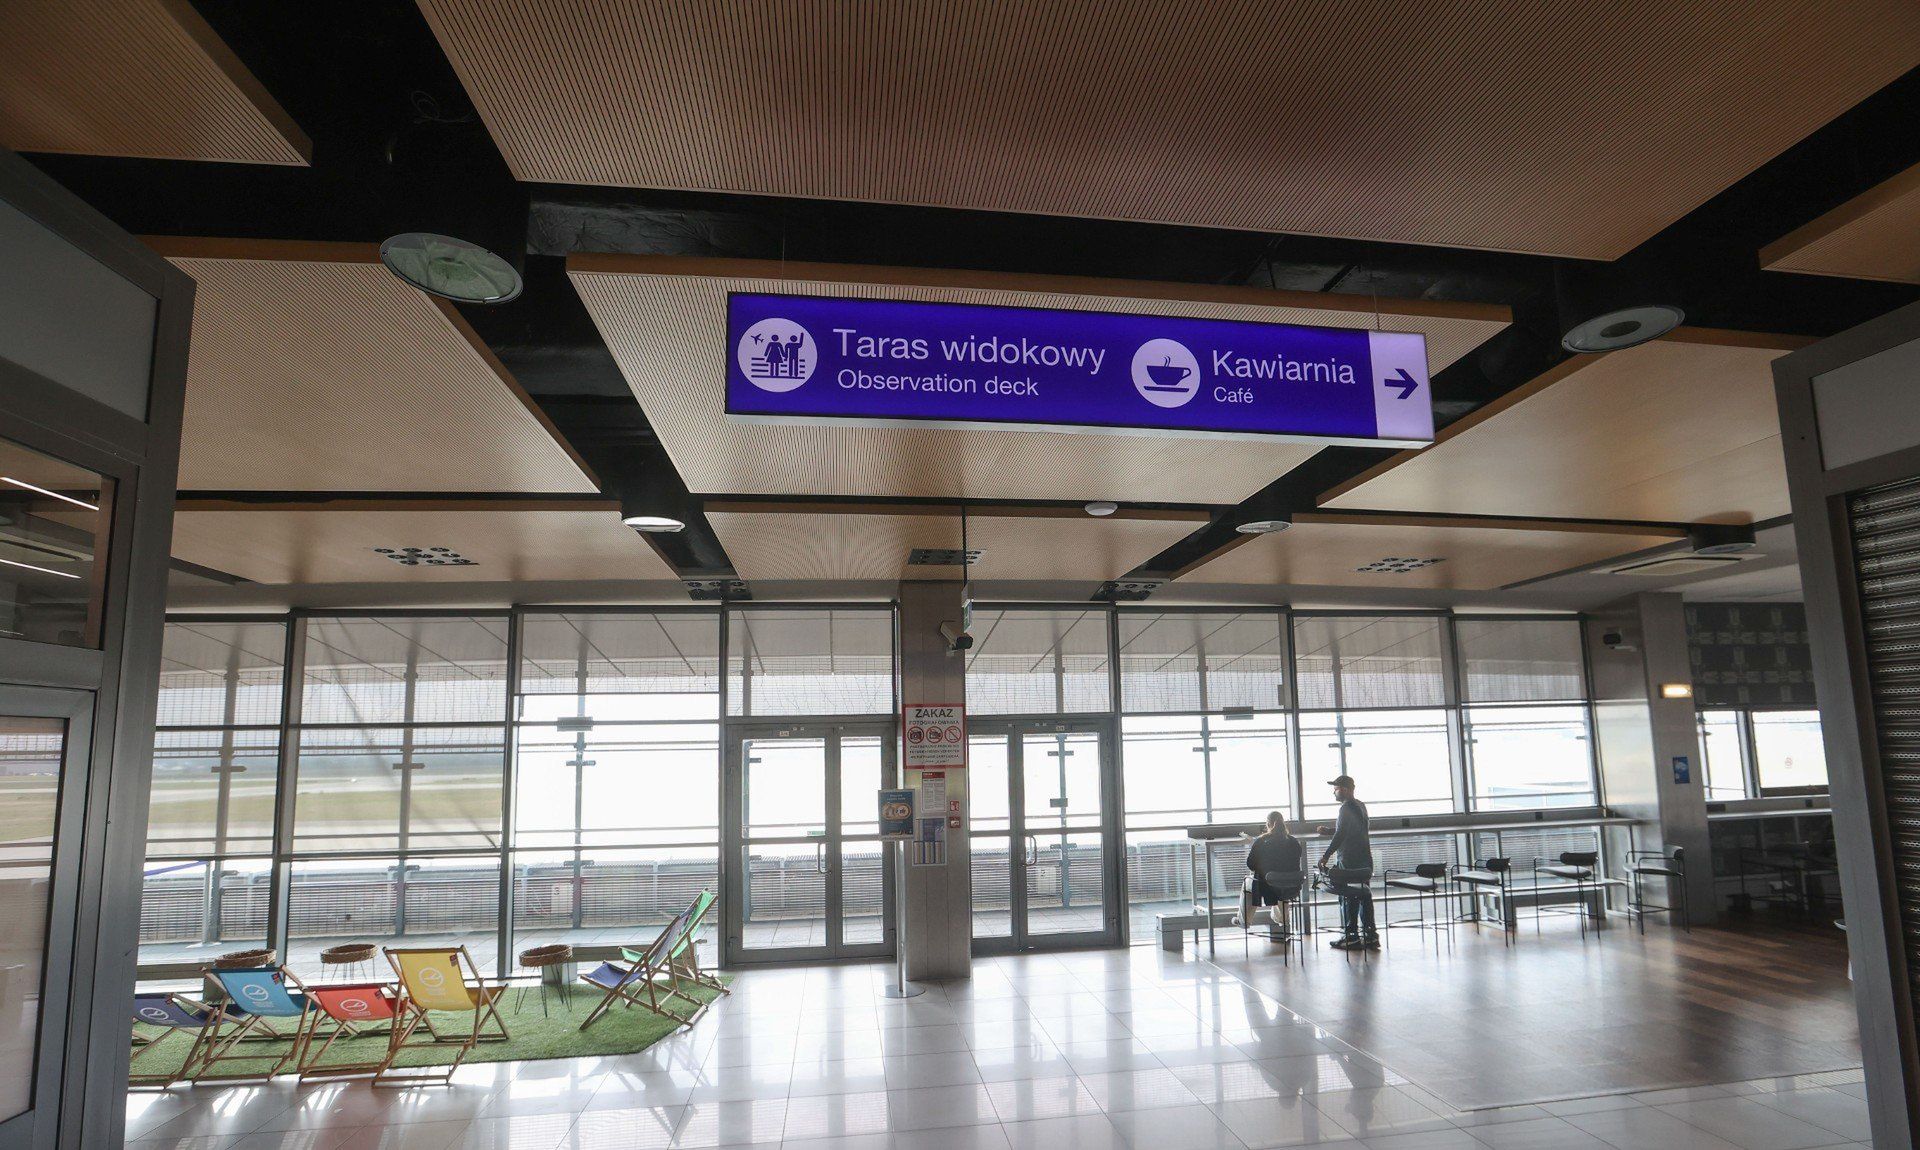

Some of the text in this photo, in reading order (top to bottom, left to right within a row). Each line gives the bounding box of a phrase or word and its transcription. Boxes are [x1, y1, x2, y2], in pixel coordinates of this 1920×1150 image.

[833, 328, 1106, 375] Taras widokowy
[1212, 350, 1356, 384] Kawiarnia
[837, 368, 1040, 396] Observation deck
[1213, 386, 1254, 403] Café
[915, 708, 954, 718] ZAKAZ
